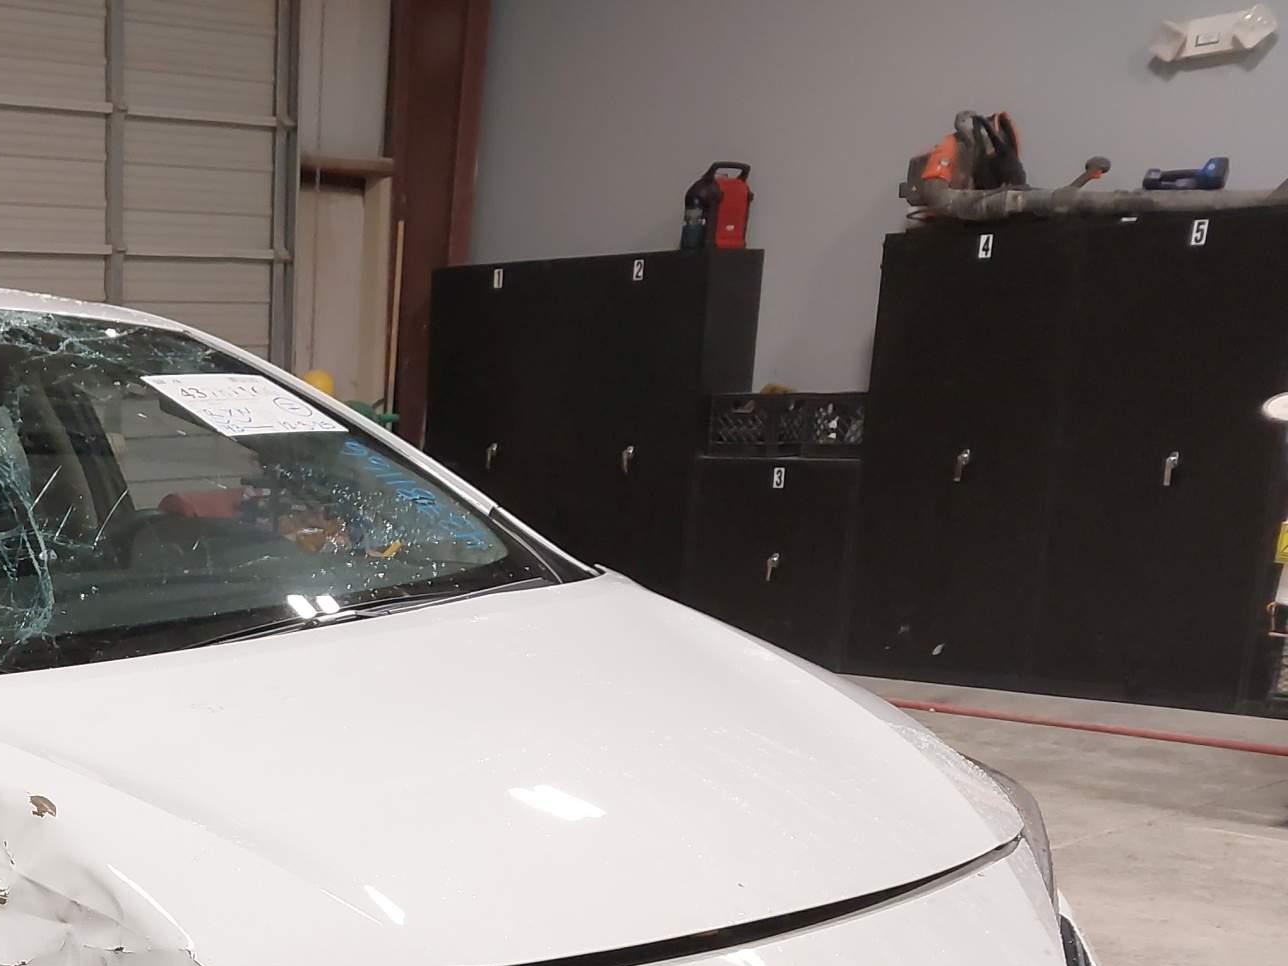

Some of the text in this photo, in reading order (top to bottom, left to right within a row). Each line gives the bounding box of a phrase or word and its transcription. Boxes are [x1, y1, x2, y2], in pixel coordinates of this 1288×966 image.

[1193, 221, 1207, 244] 5
[980, 236, 992, 257] 4
[634, 261, 643, 279] 2
[775, 469, 783, 487] 3
